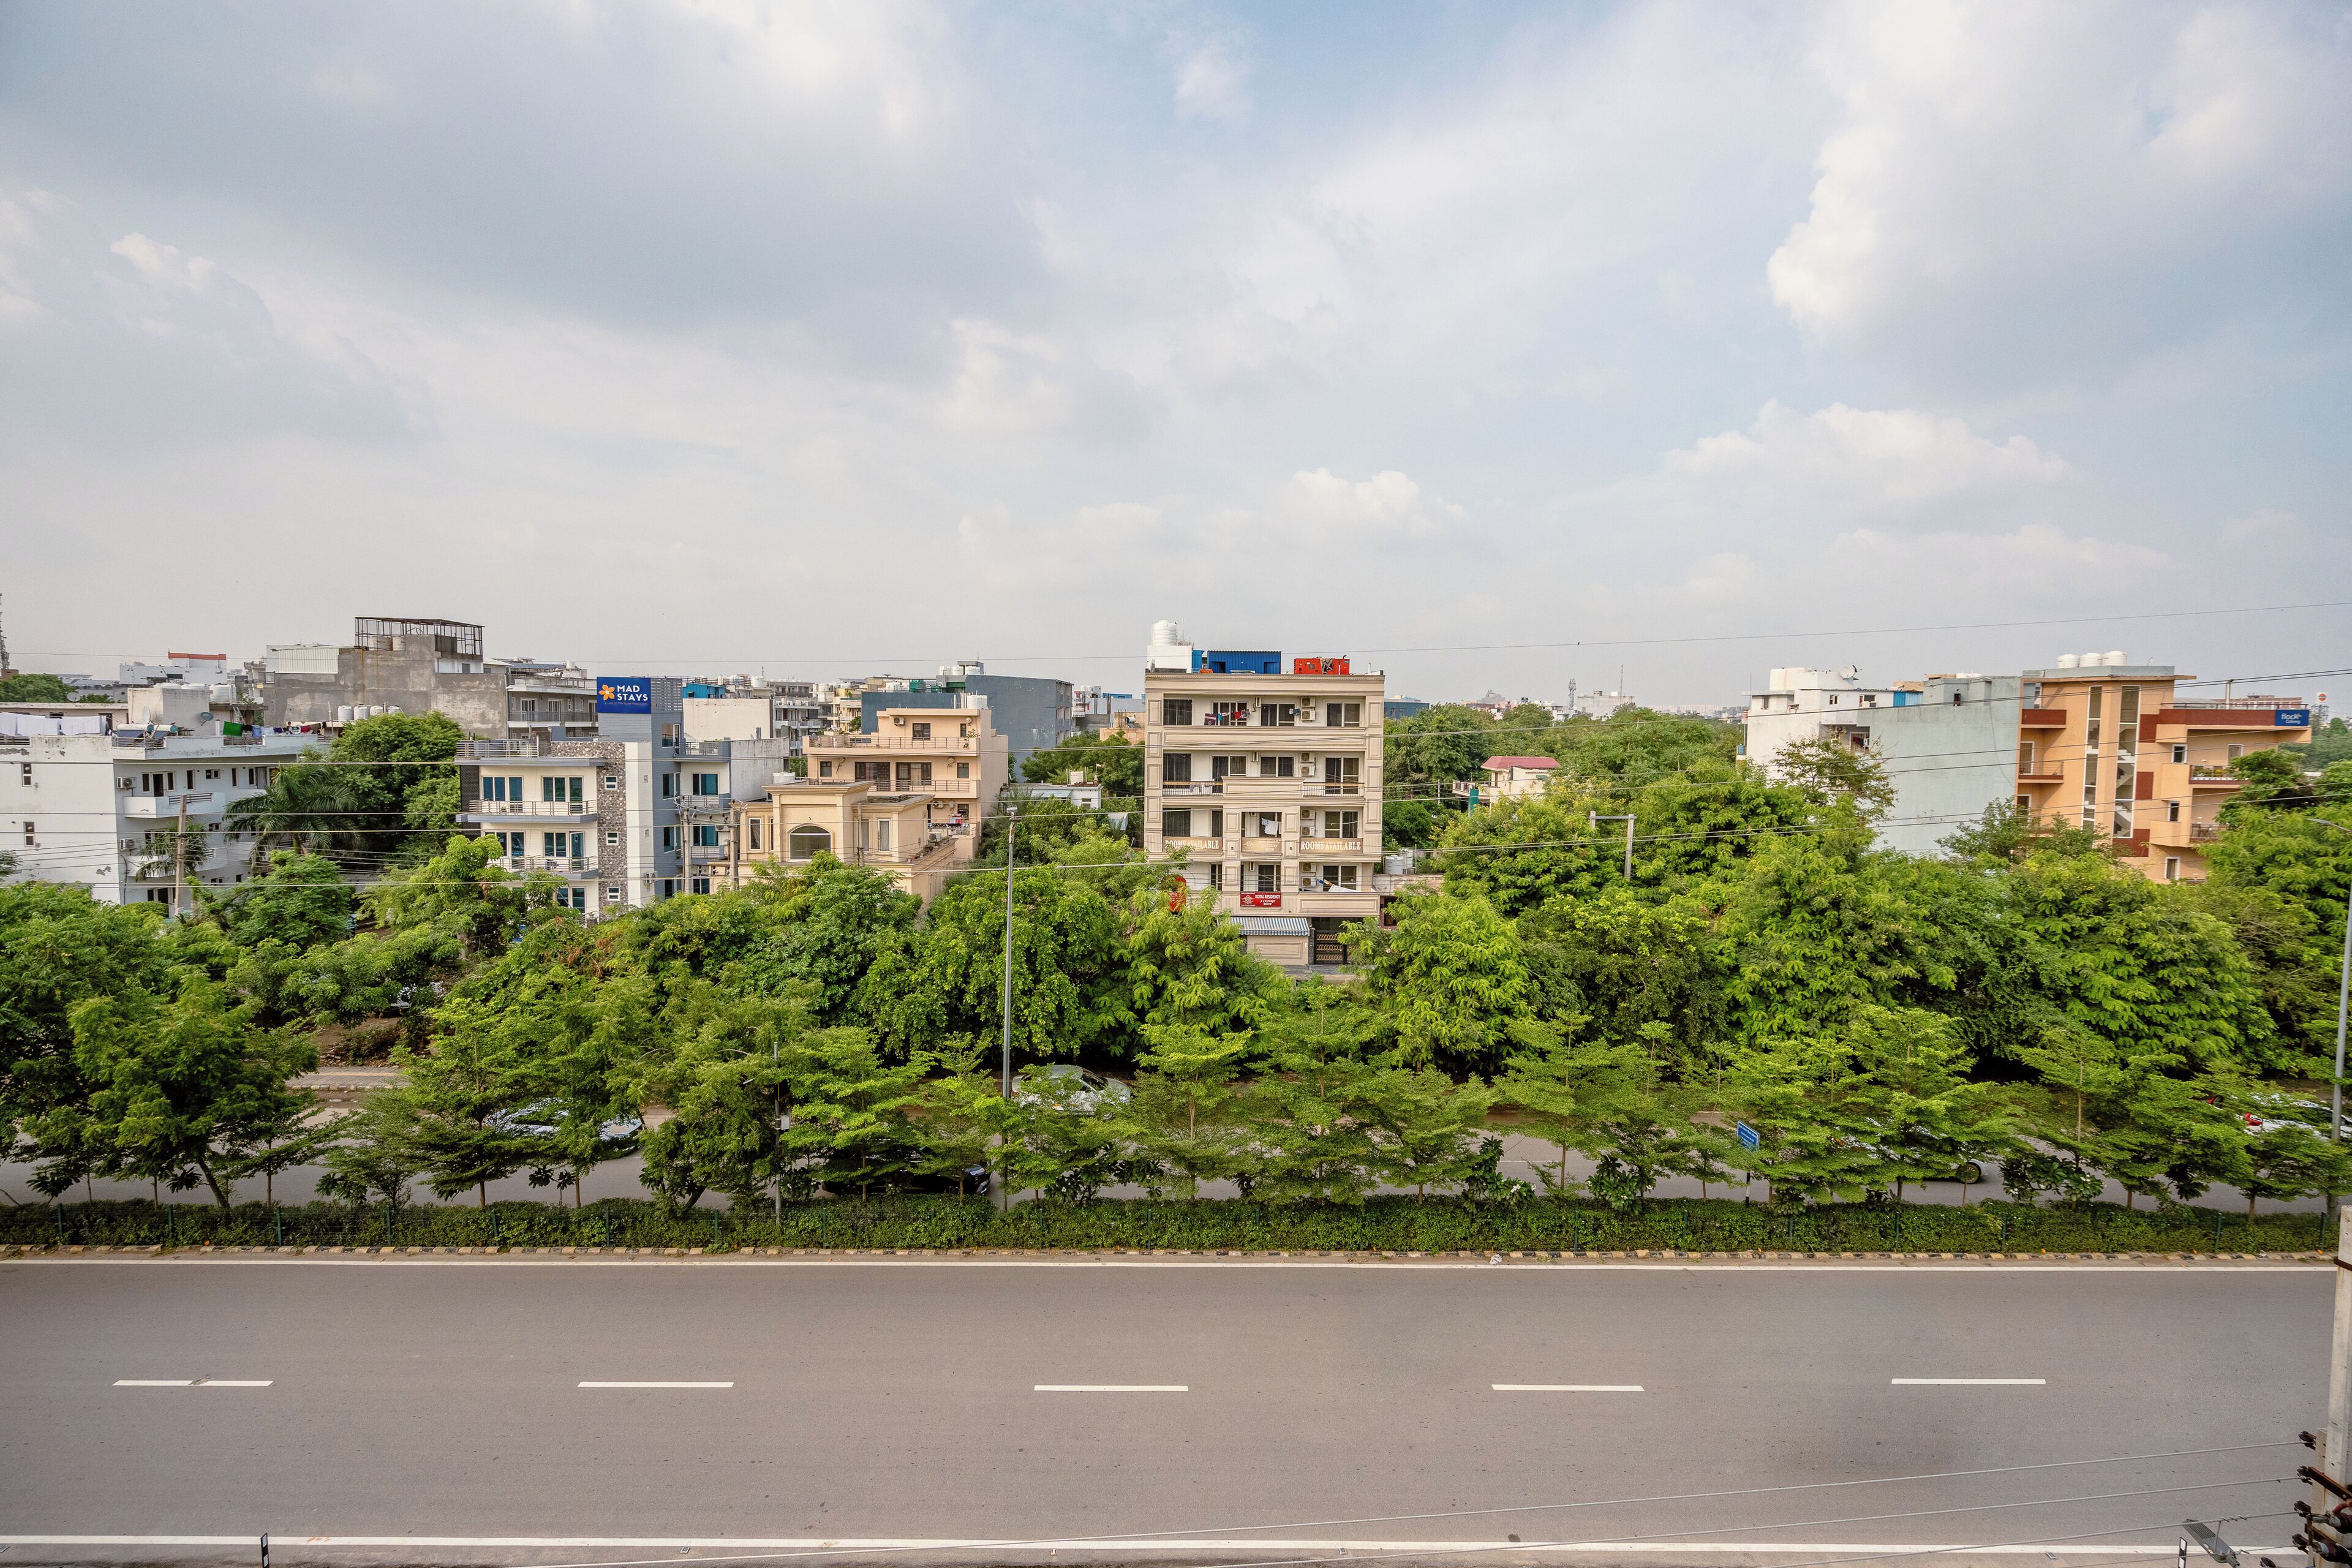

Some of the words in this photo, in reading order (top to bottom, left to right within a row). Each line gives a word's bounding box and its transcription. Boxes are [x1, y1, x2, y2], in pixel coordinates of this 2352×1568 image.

[1187, 840, 1219, 849] AVAILABLE
[1300, 842, 1324, 850] ROOMS
[1325, 842, 1361, 850] AVAILABLE
